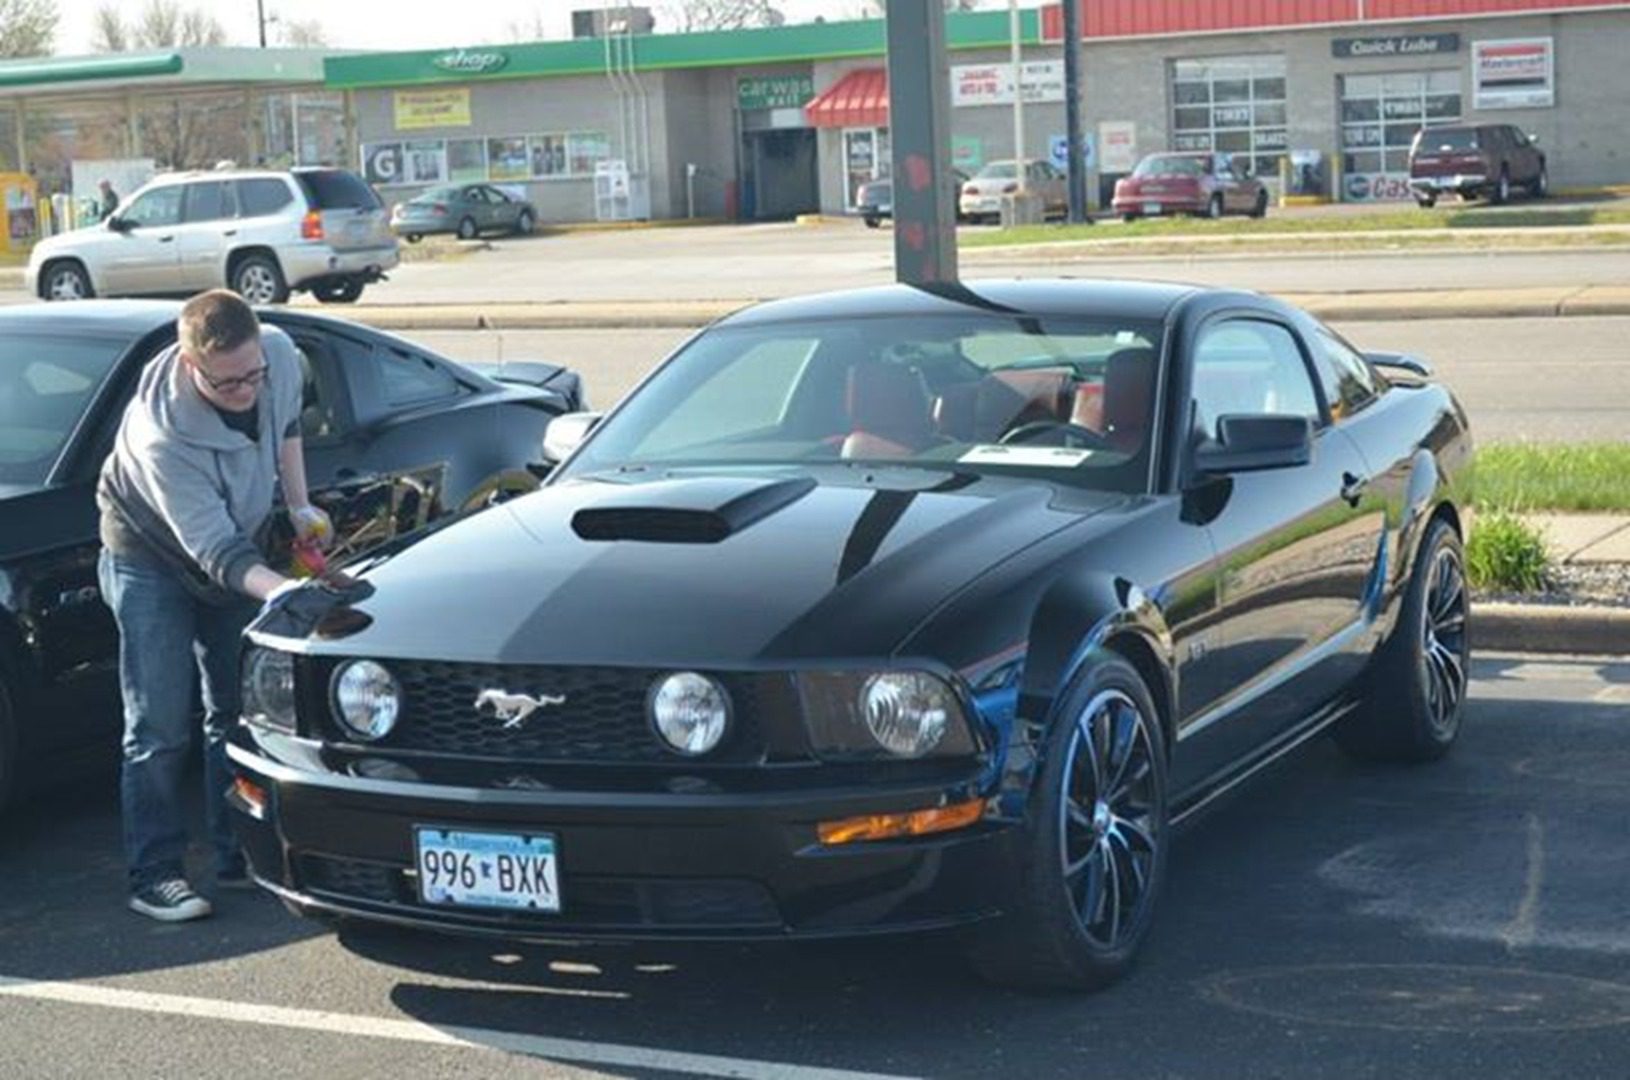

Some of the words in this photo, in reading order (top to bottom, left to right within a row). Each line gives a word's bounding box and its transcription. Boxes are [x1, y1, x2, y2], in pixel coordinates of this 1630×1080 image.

[1350, 39, 1395, 55] Quick
[1400, 37, 1438, 52] Lube
[770, 80, 812, 95] was
[373, 148, 396, 179] G
[1373, 175, 1411, 199] Cas
[423, 849, 477, 889] 996
[497, 853, 551, 895] BXK
